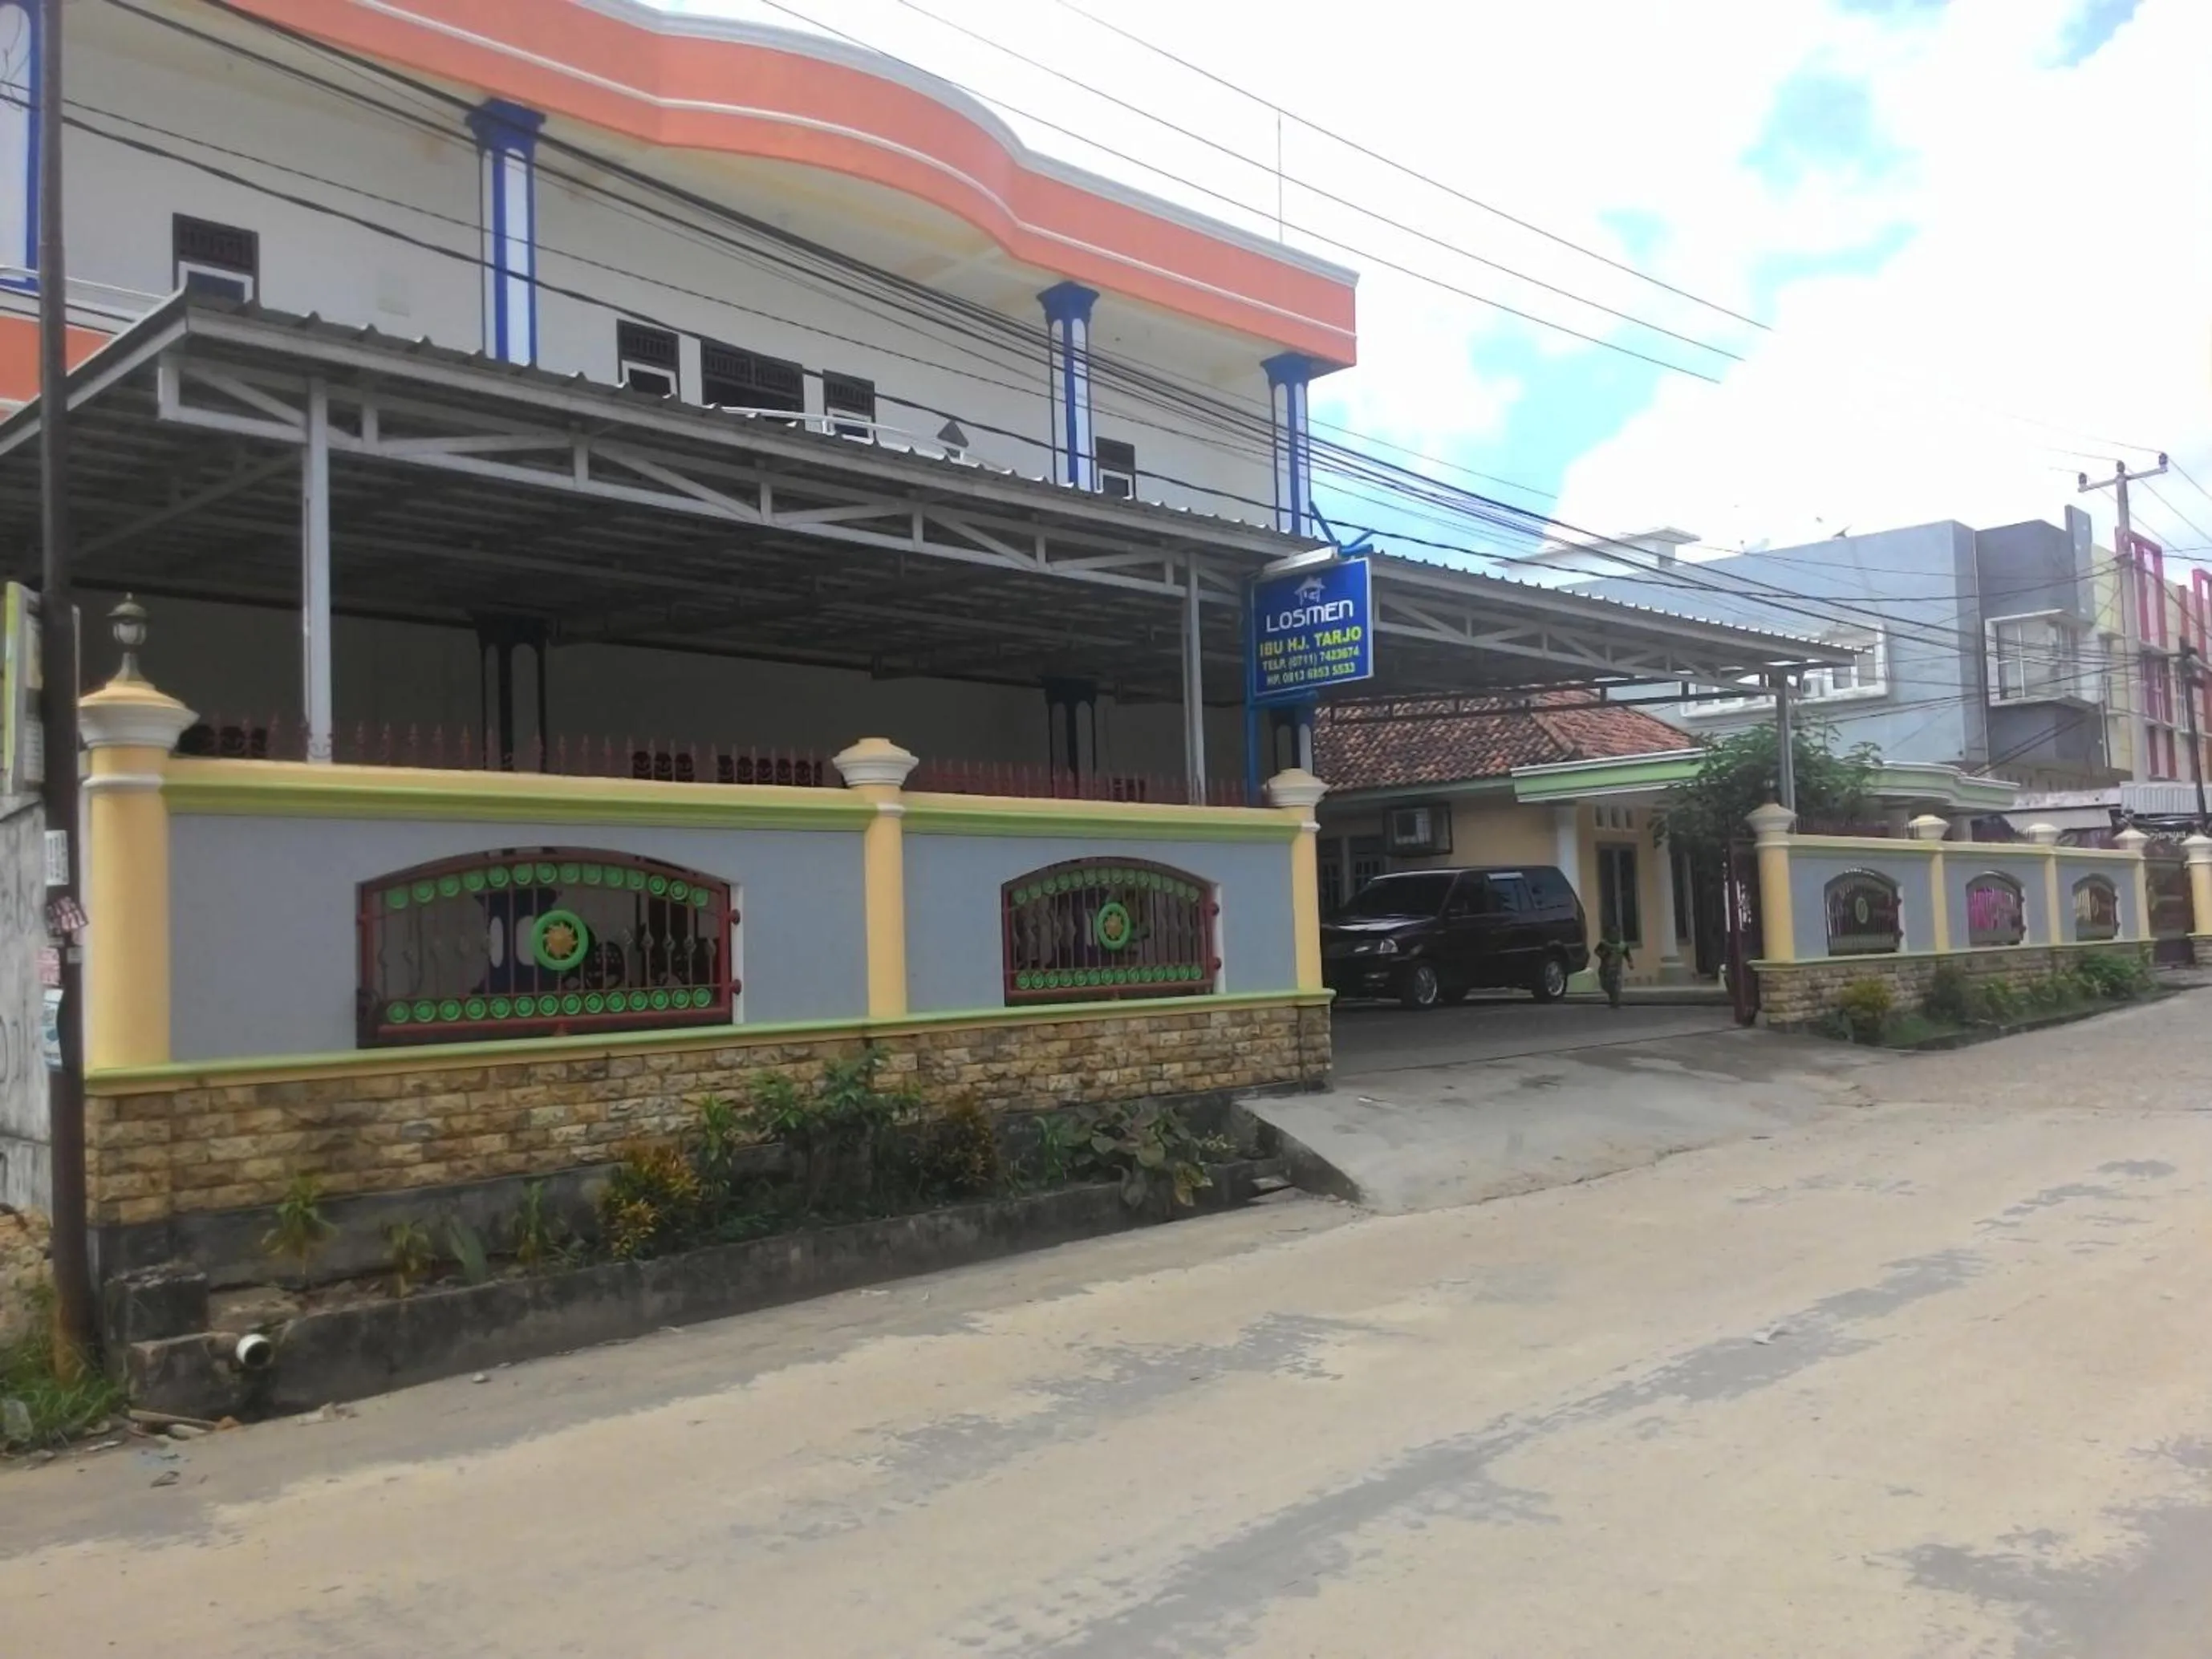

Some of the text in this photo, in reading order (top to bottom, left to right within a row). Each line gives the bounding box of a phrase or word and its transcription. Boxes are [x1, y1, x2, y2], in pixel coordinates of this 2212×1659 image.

[1260, 626, 1362, 657] IBU HJ. TARJO
